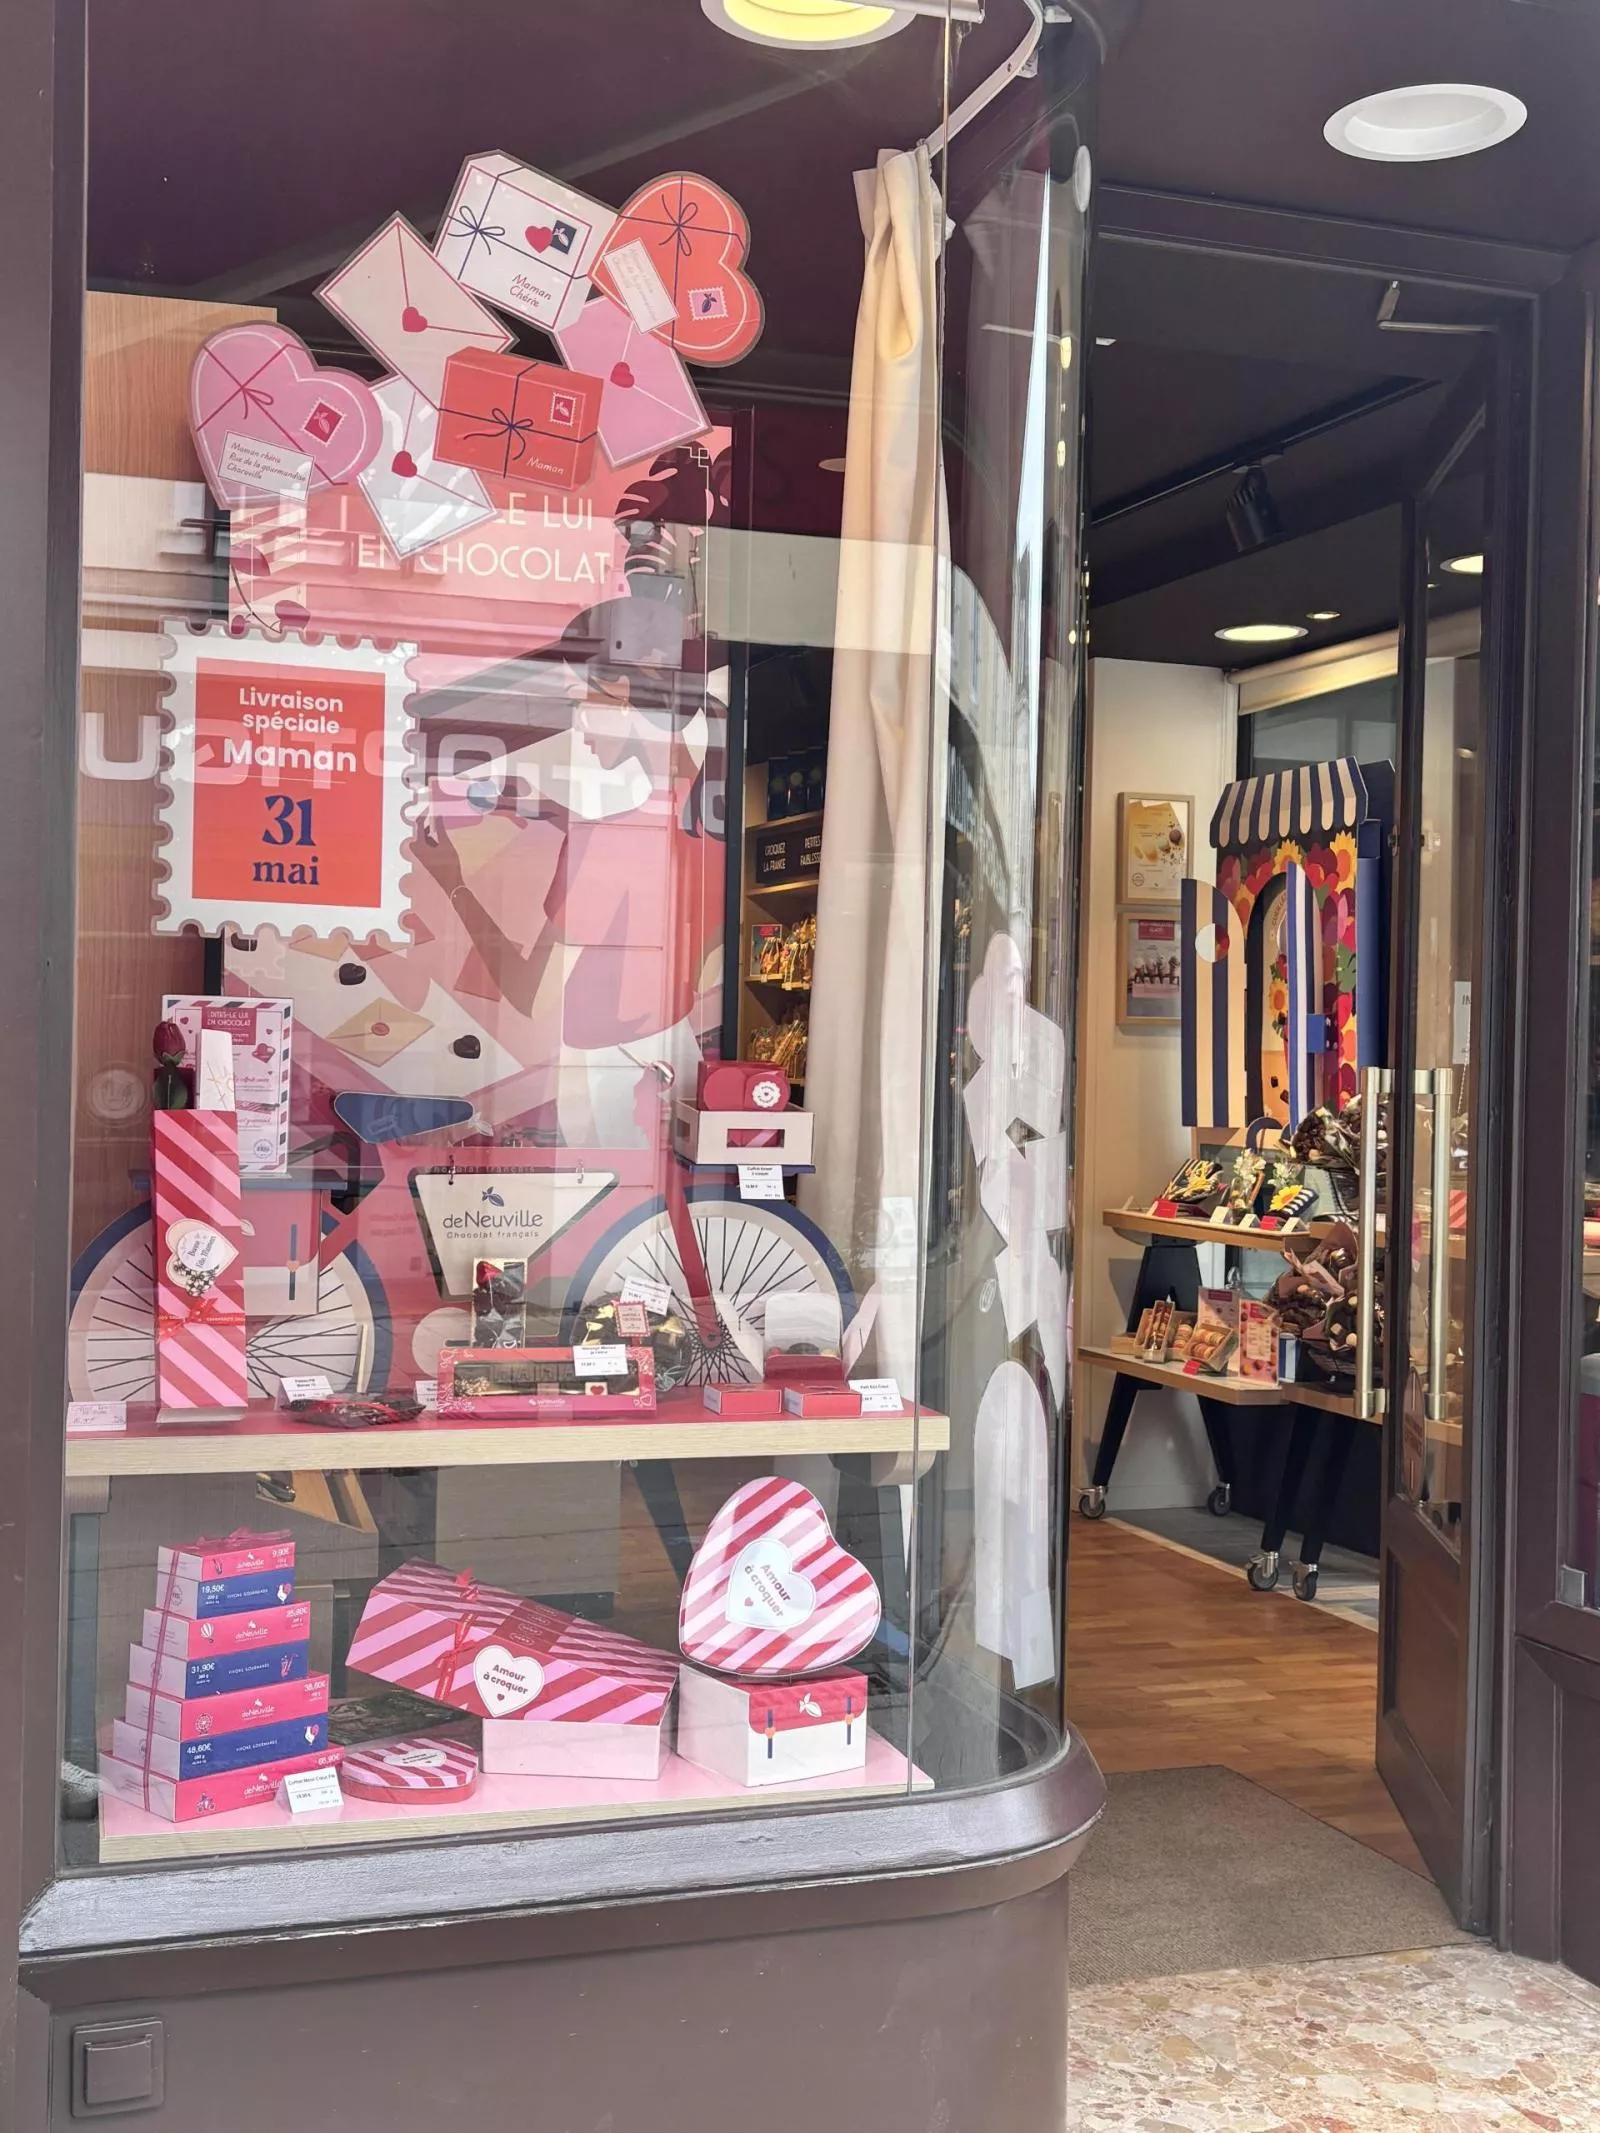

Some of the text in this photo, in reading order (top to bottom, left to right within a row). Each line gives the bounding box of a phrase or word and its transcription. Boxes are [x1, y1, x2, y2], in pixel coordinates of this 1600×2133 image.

[510, 285, 540, 307] Chérie
[512, 273, 552, 300] Maman
[526, 456, 565, 475] Maman
[543, 495, 592, 530] LUI
[420, 540, 611, 585] CHOCOLAT
[239, 687, 343, 713] Livraison
[242, 711, 341, 735] spéciale
[223, 737, 357, 773] Maman
[261, 794, 316, 847] 31
[252, 855, 320, 886] mai
[442, 1210, 543, 1229] deNeuville
[447, 1229, 540, 1240] Chocolat français
[744, 1564, 784, 1617] à croquer
[760, 1564, 792, 1601] Amour
[483, 1671, 529, 1695] à croquer
[492, 1664, 526, 1682] Amour
